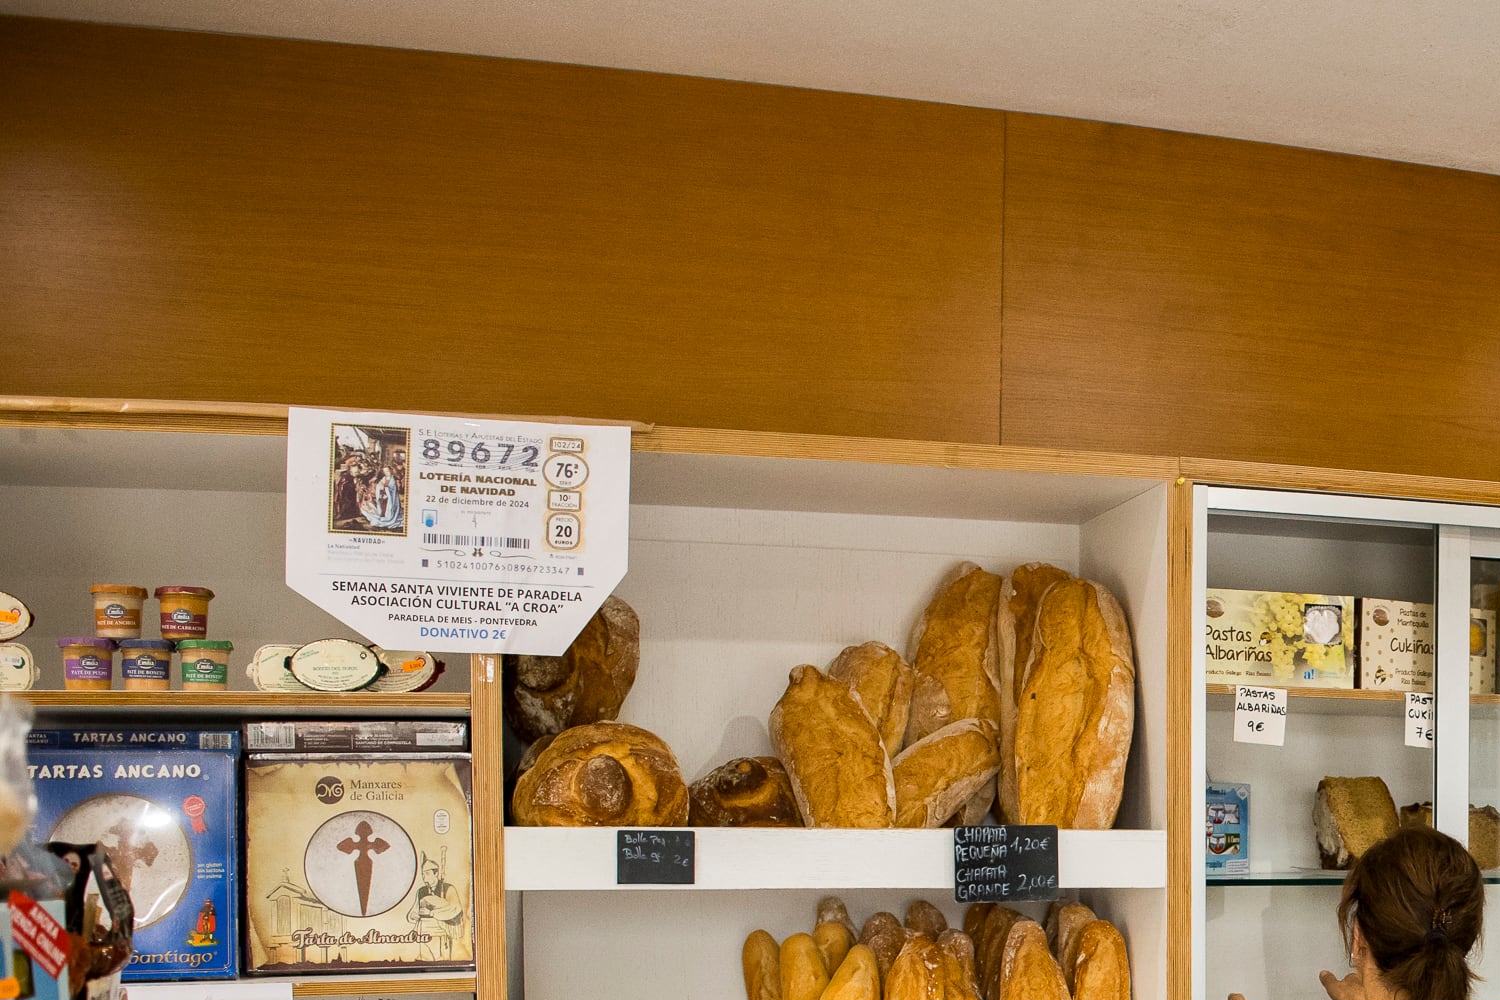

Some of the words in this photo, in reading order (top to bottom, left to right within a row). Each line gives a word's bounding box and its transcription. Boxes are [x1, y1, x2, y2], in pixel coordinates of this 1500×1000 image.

[422, 439, 539, 468] 89672
[419, 471, 471, 483] LOTERÍA
[476, 475, 537, 486] NACIONAL
[440, 485, 456, 493] DE
[460, 487, 516, 497] NAVIDAD
[426, 495, 436, 503] 22
[452, 497, 494, 505] diciembre
[496, 498, 506, 506] de
[509, 500, 529, 508] 2024
[556, 525, 572, 538] 20
[332, 581, 387, 593] SEMANA
[391, 583, 433, 595] SANTA
[437, 585, 496, 598] VIVIENTE
[499, 587, 514, 598] DE
[518, 589, 582, 601] PARADELA
[351, 594, 432, 608] ASOCIACIÓN
[436, 599, 502, 611] CULTURAL
[389, 613, 435, 623] PARADELA
[438, 615, 449, 623] DE
[451, 615, 472, 624] MEIS
[480, 617, 537, 626] PONTEVEDRA
[1419, 609, 1427, 617] de
[420, 627, 489, 640] DONATIVO
[492, 629, 506, 640] 2€
[1206, 625, 1252, 643] Pastas
[1205, 646, 1272, 663] Albariñas
[1240, 687, 1275, 700] PASTAS
[1247, 720, 1264, 733] 9€
[73, 732, 124, 743] TARTAS
[130, 732, 186, 743] ANCANO
[27, 764, 103, 779] TARTAS
[115, 764, 201, 779] ANCANO
[350, 779, 402, 790] Manxares
[350, 791, 360, 800] de
[363, 790, 404, 801] Galicia
[955, 827, 1007, 844] CHAPATA
[1010, 836, 1051, 854] 1,20€
[958, 883, 1010, 900] GRANDE
[292, 927, 337, 949] Tarta
[338, 931, 356, 946] de
[357, 928, 432, 945] Almendra
[129, 949, 213, 967] Santiago
